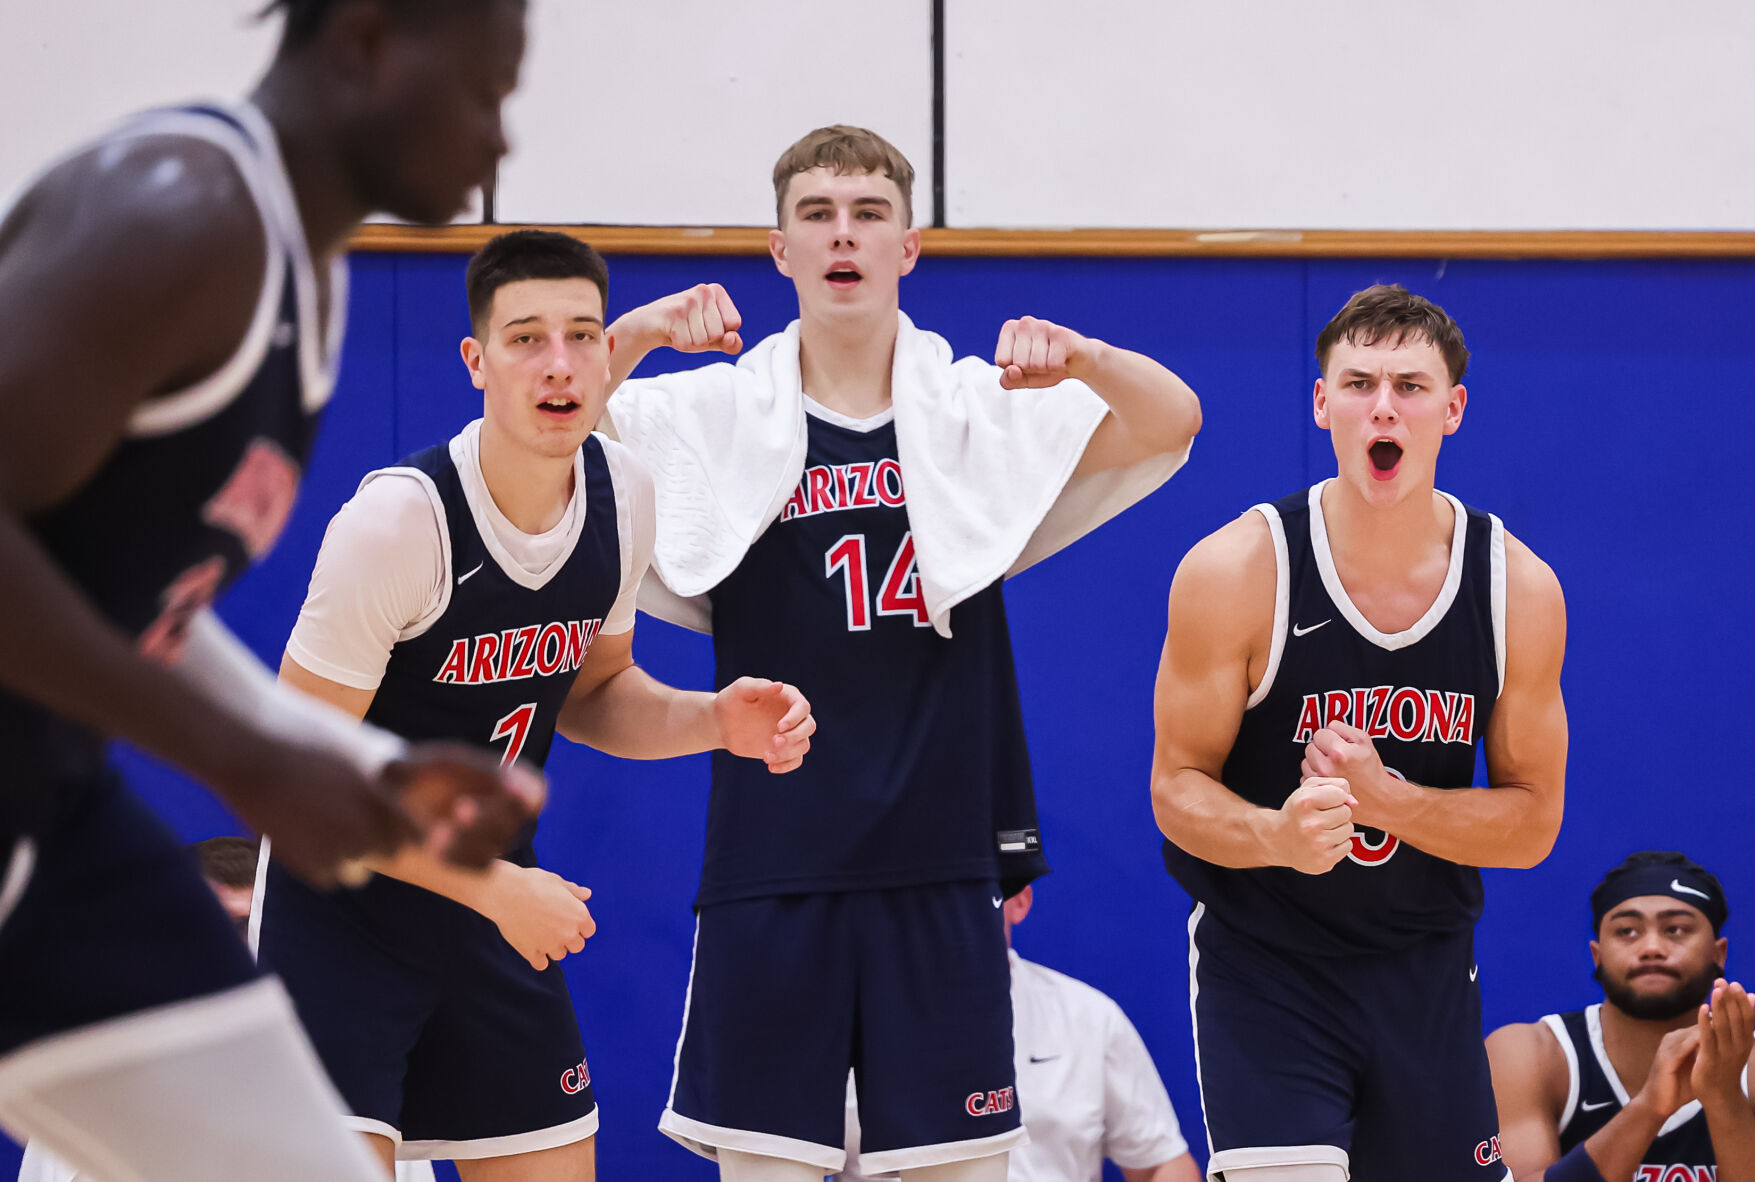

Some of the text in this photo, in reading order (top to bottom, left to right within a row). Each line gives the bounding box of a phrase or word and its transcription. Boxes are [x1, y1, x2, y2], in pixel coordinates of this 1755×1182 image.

[825, 531, 932, 631] 14
[490, 702, 538, 768] 1
[1292, 686, 1475, 746] ARIZONA
[965, 1086, 1014, 1116] CATS
[1474, 1133, 1502, 1166] CA
